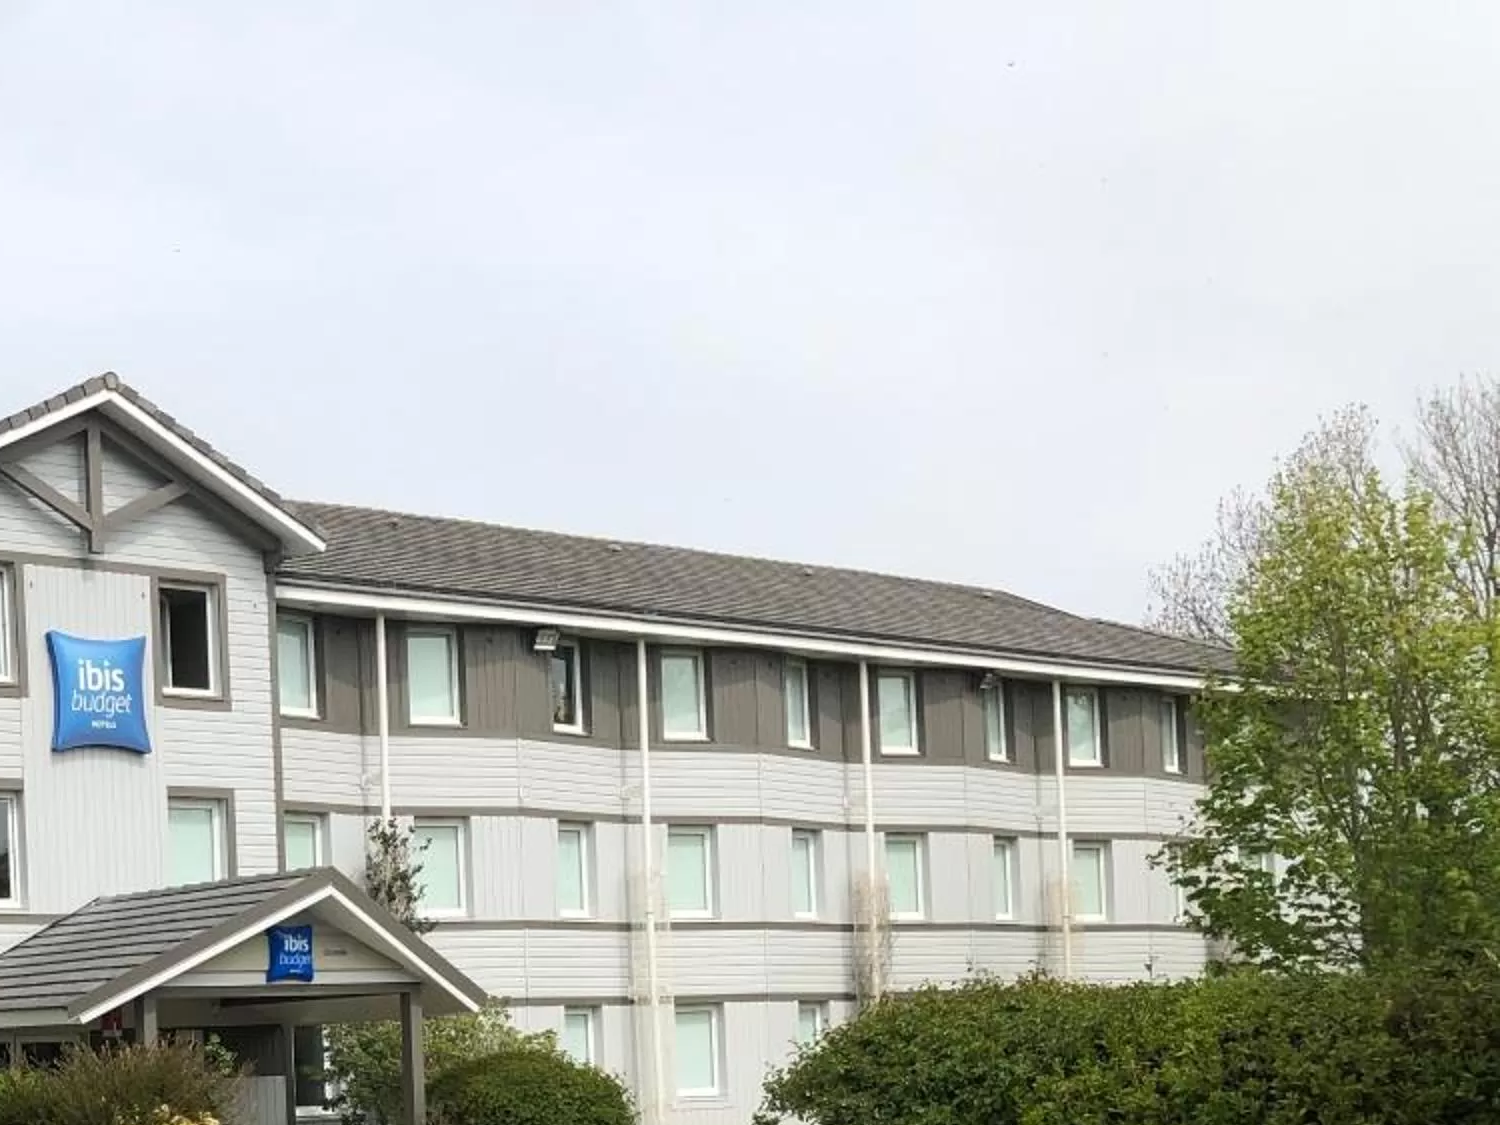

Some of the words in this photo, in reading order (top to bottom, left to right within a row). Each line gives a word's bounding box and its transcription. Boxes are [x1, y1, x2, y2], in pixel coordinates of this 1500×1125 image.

[78, 658, 125, 692] ibis
[71, 689, 132, 718] budget
[284, 934, 309, 952] ibis
